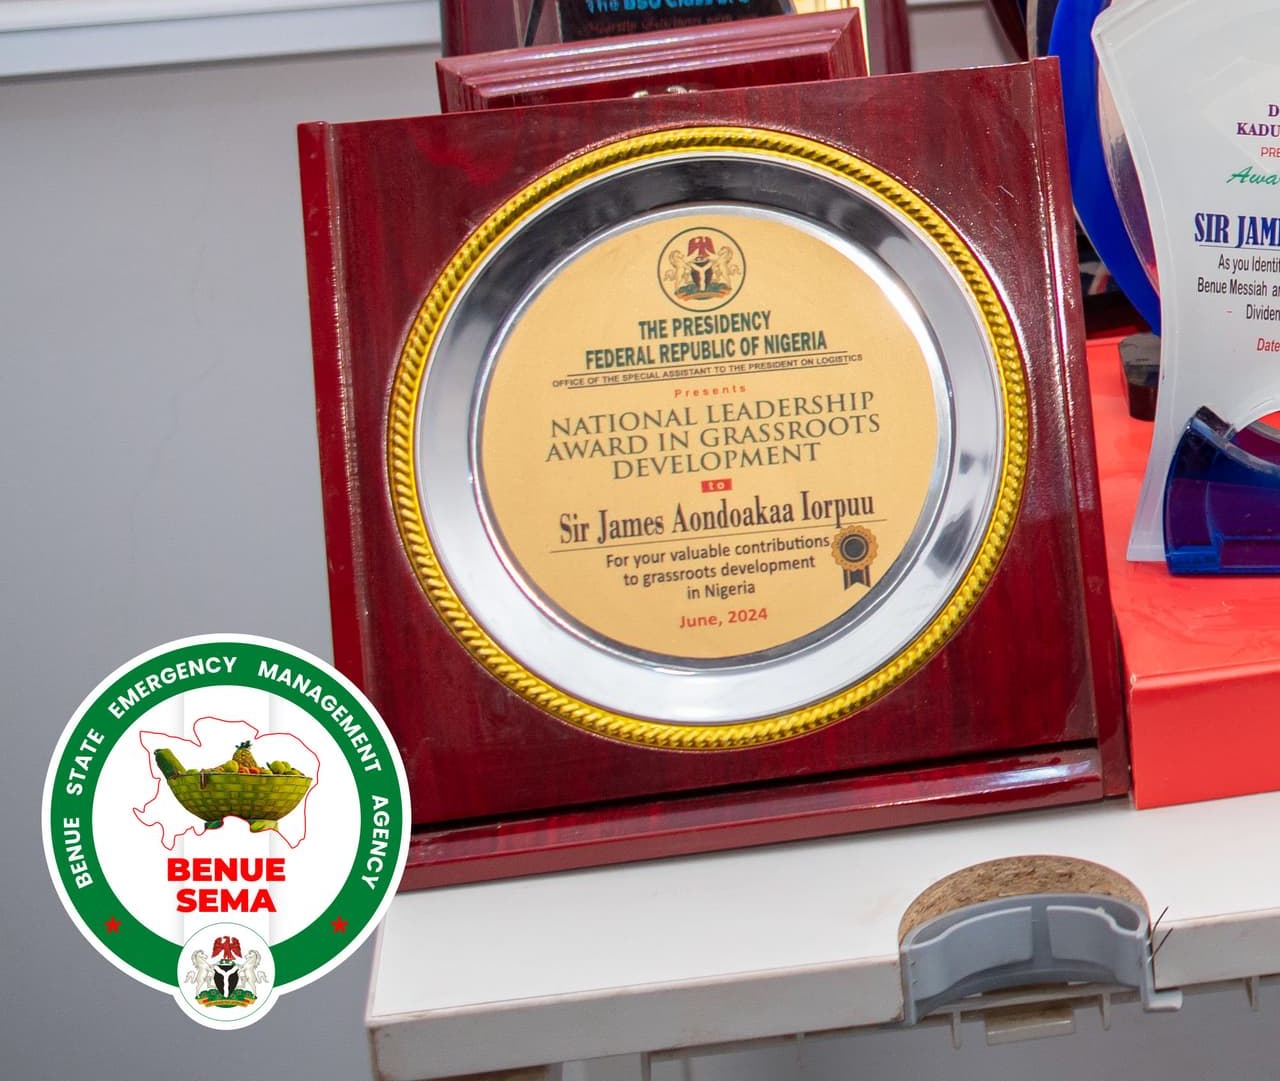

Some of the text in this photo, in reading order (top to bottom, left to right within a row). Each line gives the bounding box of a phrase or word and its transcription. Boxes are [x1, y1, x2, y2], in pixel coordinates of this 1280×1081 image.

[1194, 212, 1229, 244] SIR
[638, 310, 772, 340] THE PRESIDENCY
[585, 330, 827, 370] FEDERAL REPUBLIC OF NIGERIA
[674, 384, 747, 399] Presents
[551, 390, 875, 439] NATIONAL LEADERSHIP
[545, 413, 882, 463] AWARD IN GRASSROOTS
[612, 442, 821, 480] DEVELOPMENT
[708, 480, 726, 491] to
[559, 489, 875, 545] Sir James Aondoakaa Iorpuu
[606, 535, 830, 570] For your valuable contributions
[623, 555, 816, 588] to grassroots development
[687, 580, 756, 602] in Nigeria
[679, 607, 769, 629] June, 2024
